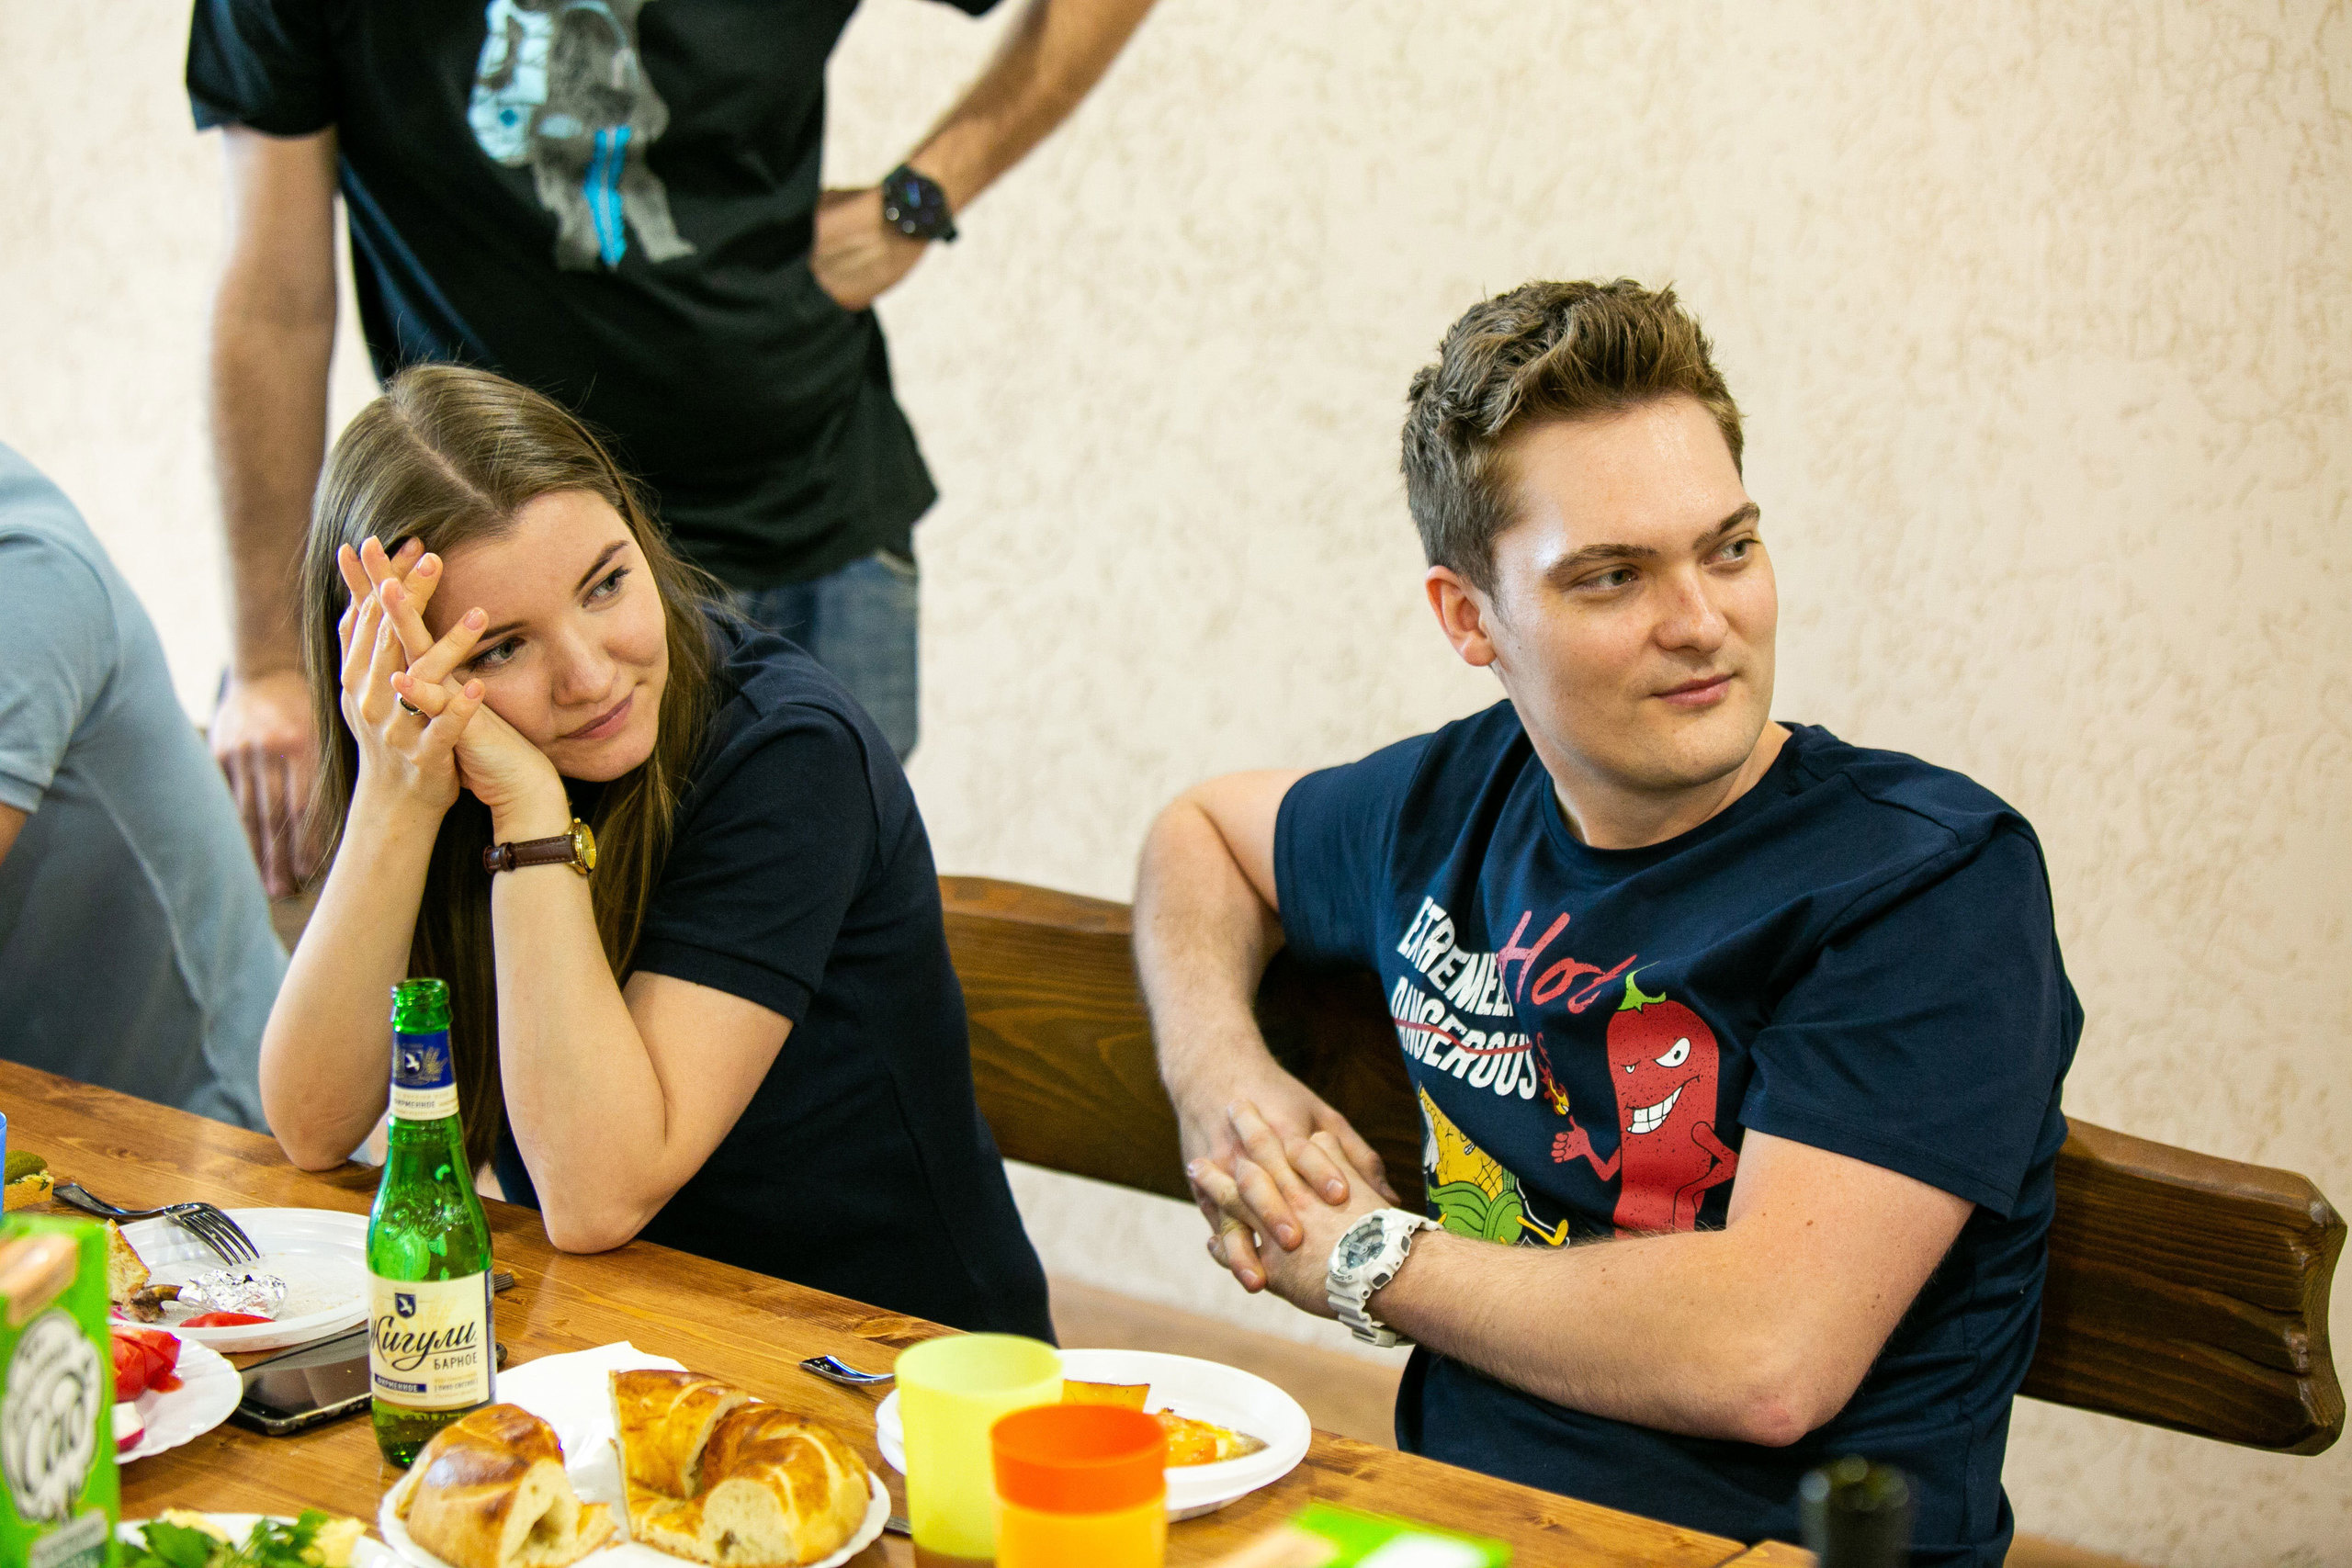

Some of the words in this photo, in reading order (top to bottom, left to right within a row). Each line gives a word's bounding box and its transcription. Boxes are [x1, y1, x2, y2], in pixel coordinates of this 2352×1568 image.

[1396, 895, 1514, 1017] EXTREMEL
[1390, 976, 1537, 1100] DANGEROUS
[434, 1352, 478, 1371] БАРНОЕ
